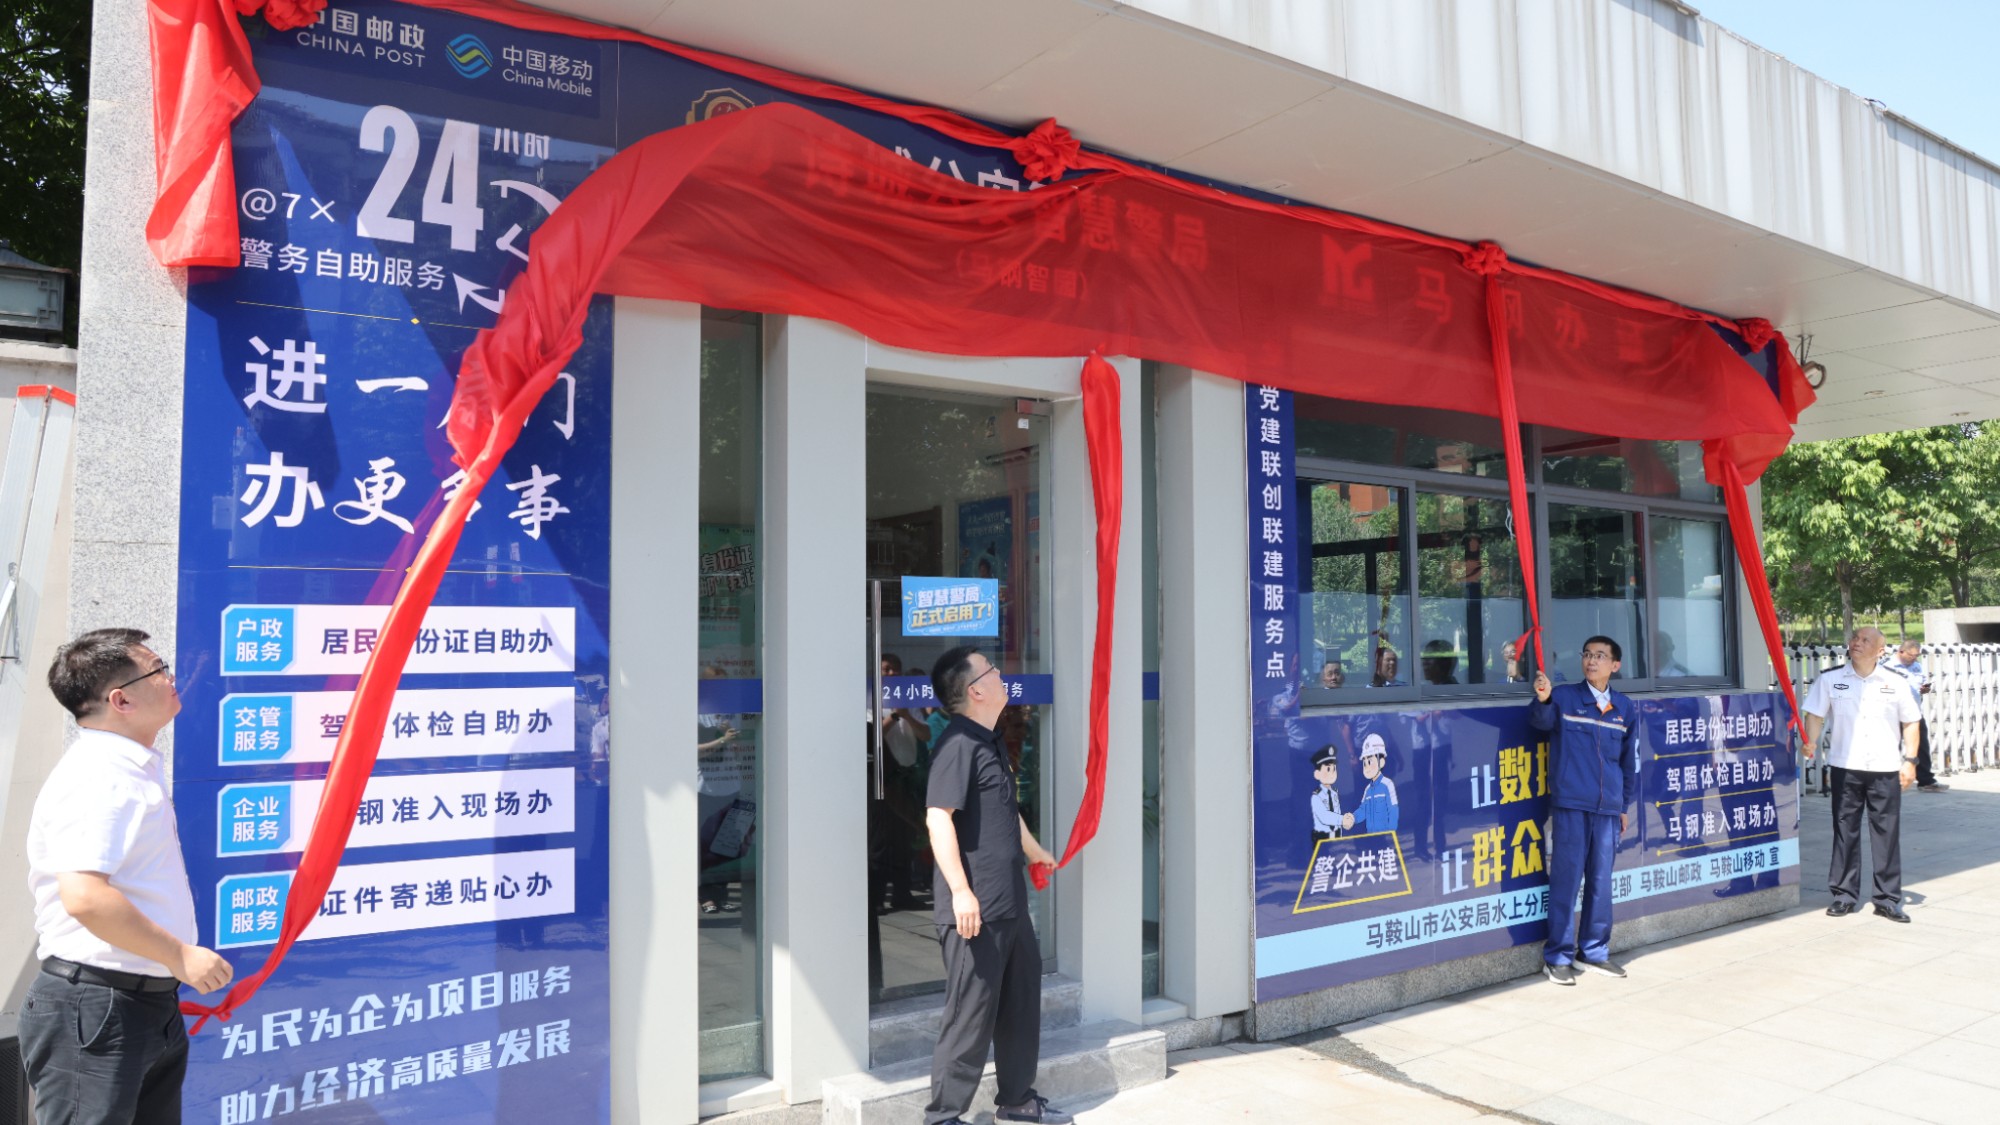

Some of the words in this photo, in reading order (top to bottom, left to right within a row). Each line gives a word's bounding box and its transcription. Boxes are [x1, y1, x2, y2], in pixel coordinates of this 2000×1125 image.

[296, 31, 366, 59] CHINA
[374, 45, 426, 68] POST
[502, 45, 593, 82] 中国移动
[502, 68, 544, 90] China
[546, 76, 593, 97] Mobile
[356, 104, 485, 252] 24
[493, 127, 550, 160] 小时
[240, 237, 446, 291] 警务自助服务
[243, 335, 577, 440] 进一门
[1259, 385, 1285, 678] 党建联创联建服务点
[917, 586, 980, 608] 智慧警局
[236, 618, 283, 640] 户政
[321, 628, 554, 656] 居民份证自助办
[235, 642, 283, 663] 服务
[234, 706, 281, 728] 交管
[319, 708, 554, 740] 驾体检自助办
[1665, 712, 1773, 746] 居民身份证自助办
[233, 730, 281, 753] 服务
[1666, 757, 1775, 792] 驾照体检自助办
[232, 796, 280, 819] 企业
[356, 788, 554, 826] 钢准入现场办
[1668, 802, 1776, 842] 马钢准入现场办
[232, 820, 280, 843] 服务
[1309, 847, 1399, 895] 警企共建
[1640, 863, 1703, 893] 马鞍山邮政
[1709, 848, 1766, 878] 马鞍山移动
[231, 886, 279, 909] 邮政
[318, 871, 554, 917] 证件寄递贴心办
[230, 910, 279, 934] 服务
[221, 965, 572, 1060] 为民为企为项目服务
[219, 1019, 572, 1125] 助力经济高质量发展
